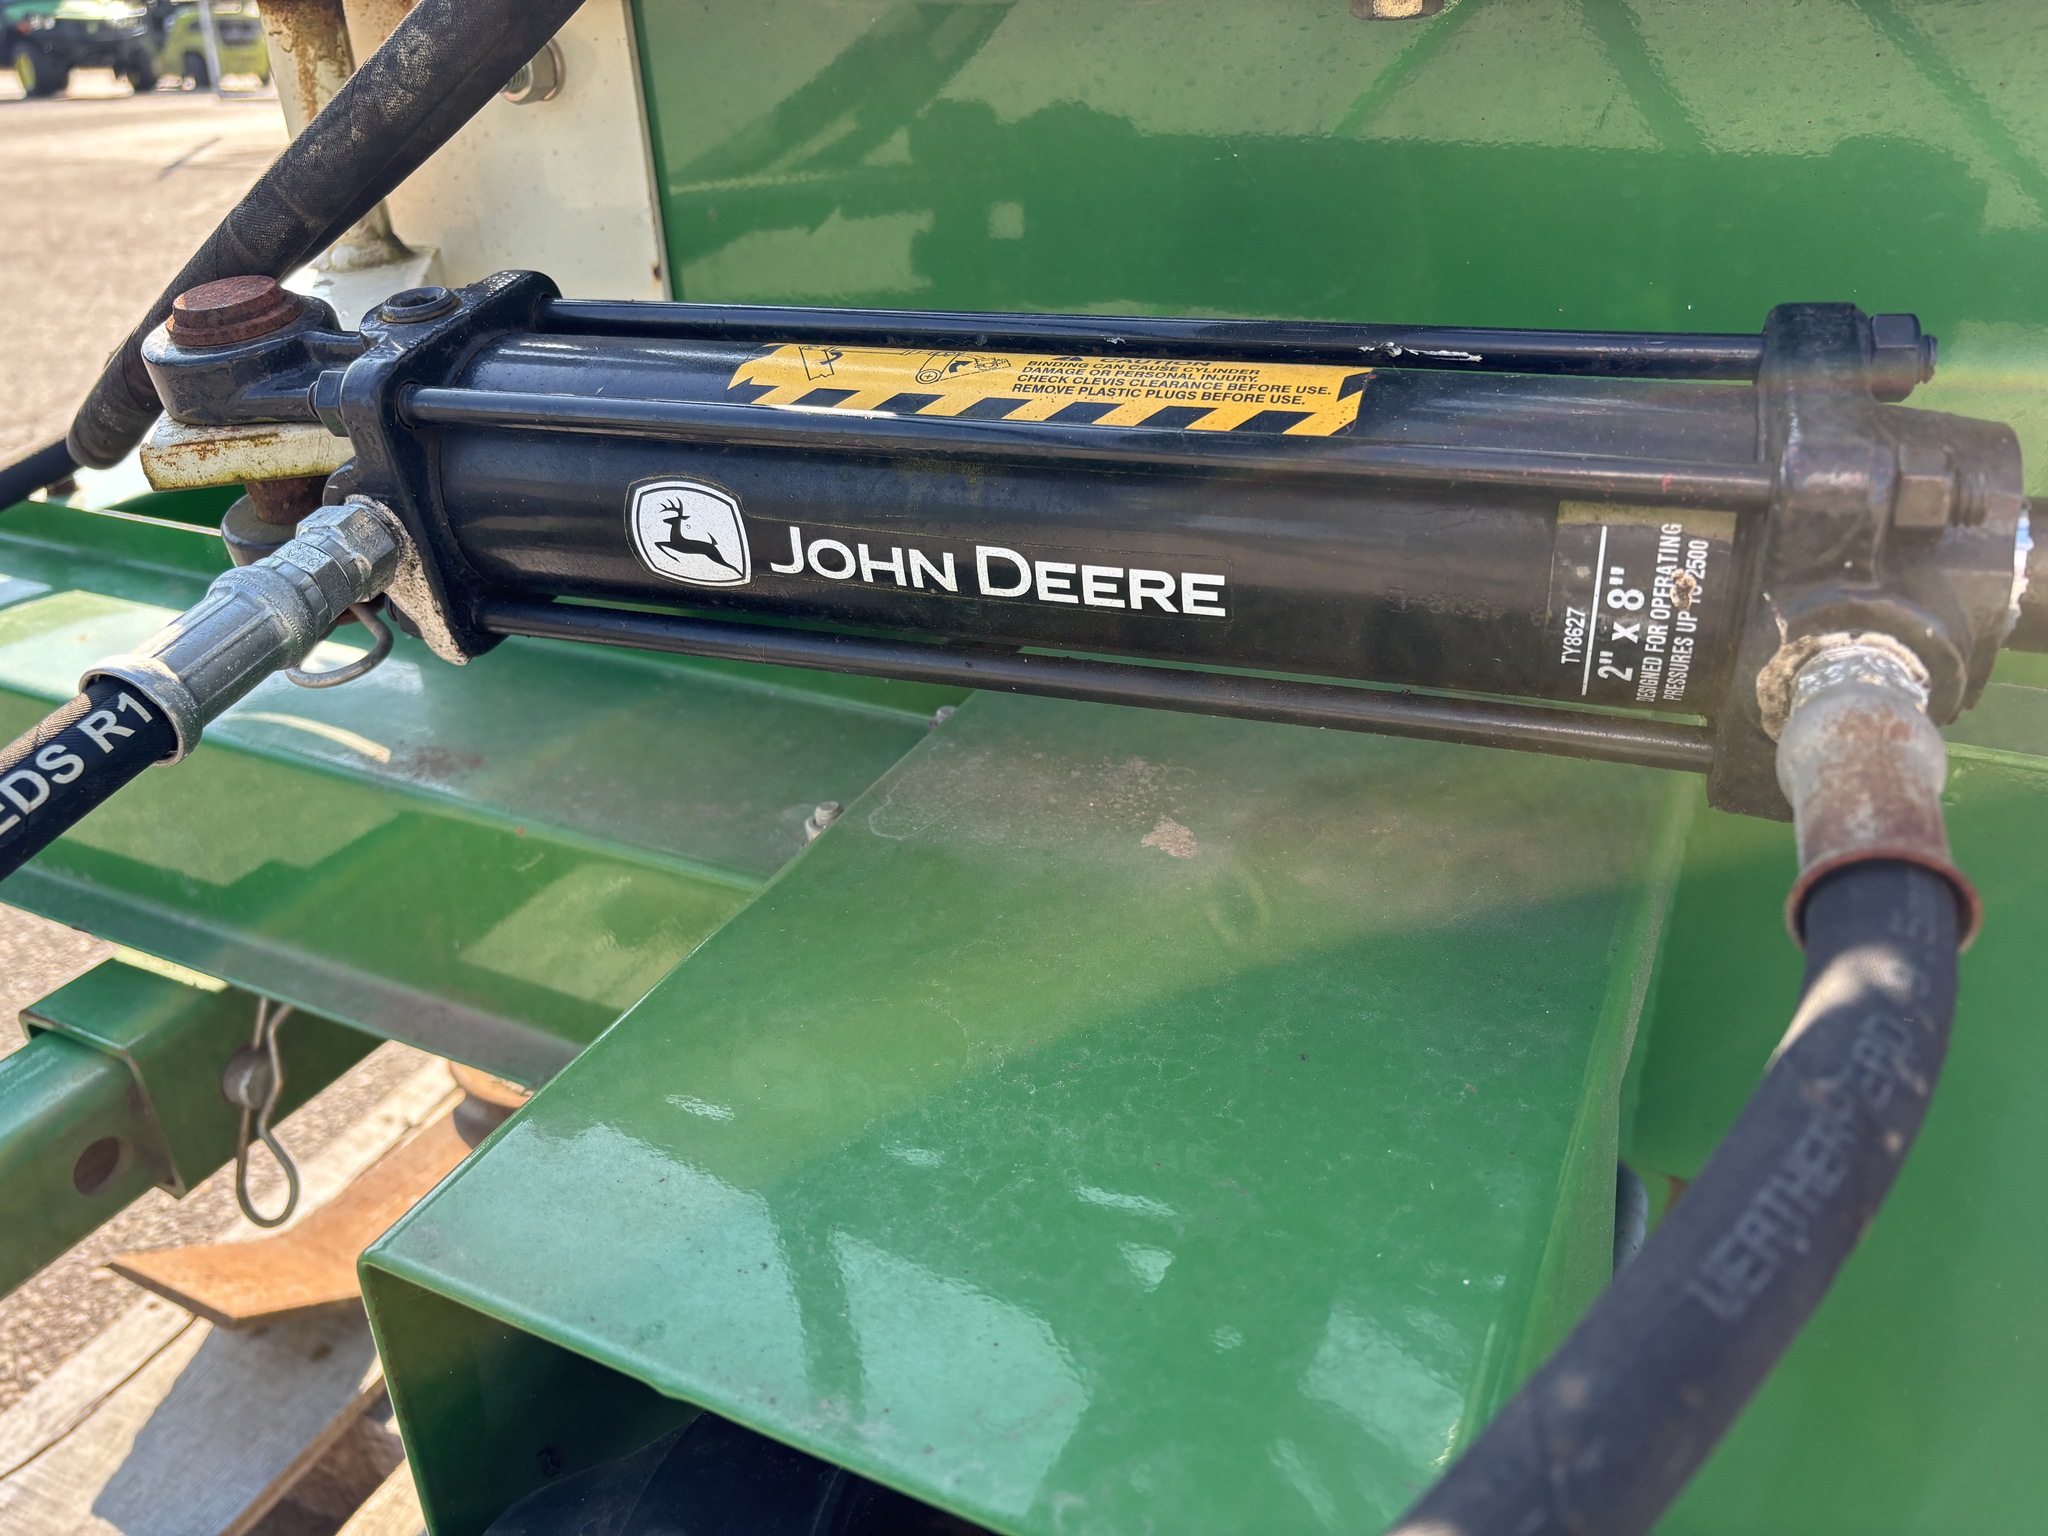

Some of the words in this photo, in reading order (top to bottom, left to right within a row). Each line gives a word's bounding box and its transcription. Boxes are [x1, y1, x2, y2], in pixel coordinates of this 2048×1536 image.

[1017, 375, 1069, 384] CHECK
[1072, 377, 1125, 387] CLEVIS
[1129, 380, 1224, 391] CLEARANCE
[1226, 384, 1292, 393] BEFORE
[1295, 386, 1332, 395] USE.
[1022, 367, 1088, 376] DAMAGE
[1114, 372, 1196, 380] PERSONAL
[1200, 374, 1258, 383] INJURY.
[1027, 361, 1089, 369] BINDING
[1128, 365, 1179, 373] CAUSE
[1183, 367, 1260, 375] CYLINDER
[1012, 384, 1075, 395] REMOVE
[1077, 387, 1141, 398] PLASTIC
[1144, 390, 1197, 400] PLUGS
[1200, 392, 1264, 403] BEFORE
[1269, 396, 1306, 405] USE.
[770, 526, 958, 593] JOHN
[975, 545, 1227, 617] DEERE
[1650, 523, 1683, 620] OPERATING
[1684, 540, 1709, 580] 2500
[1561, 606, 1587, 664] TY8627
[1644, 624, 1669, 653] FOR
[1675, 610, 1698, 633] UP
[1636, 654, 1663, 703] DESIGNED
[1663, 636, 1694, 701] PRESSURES
[77, 692, 153, 754] R1
